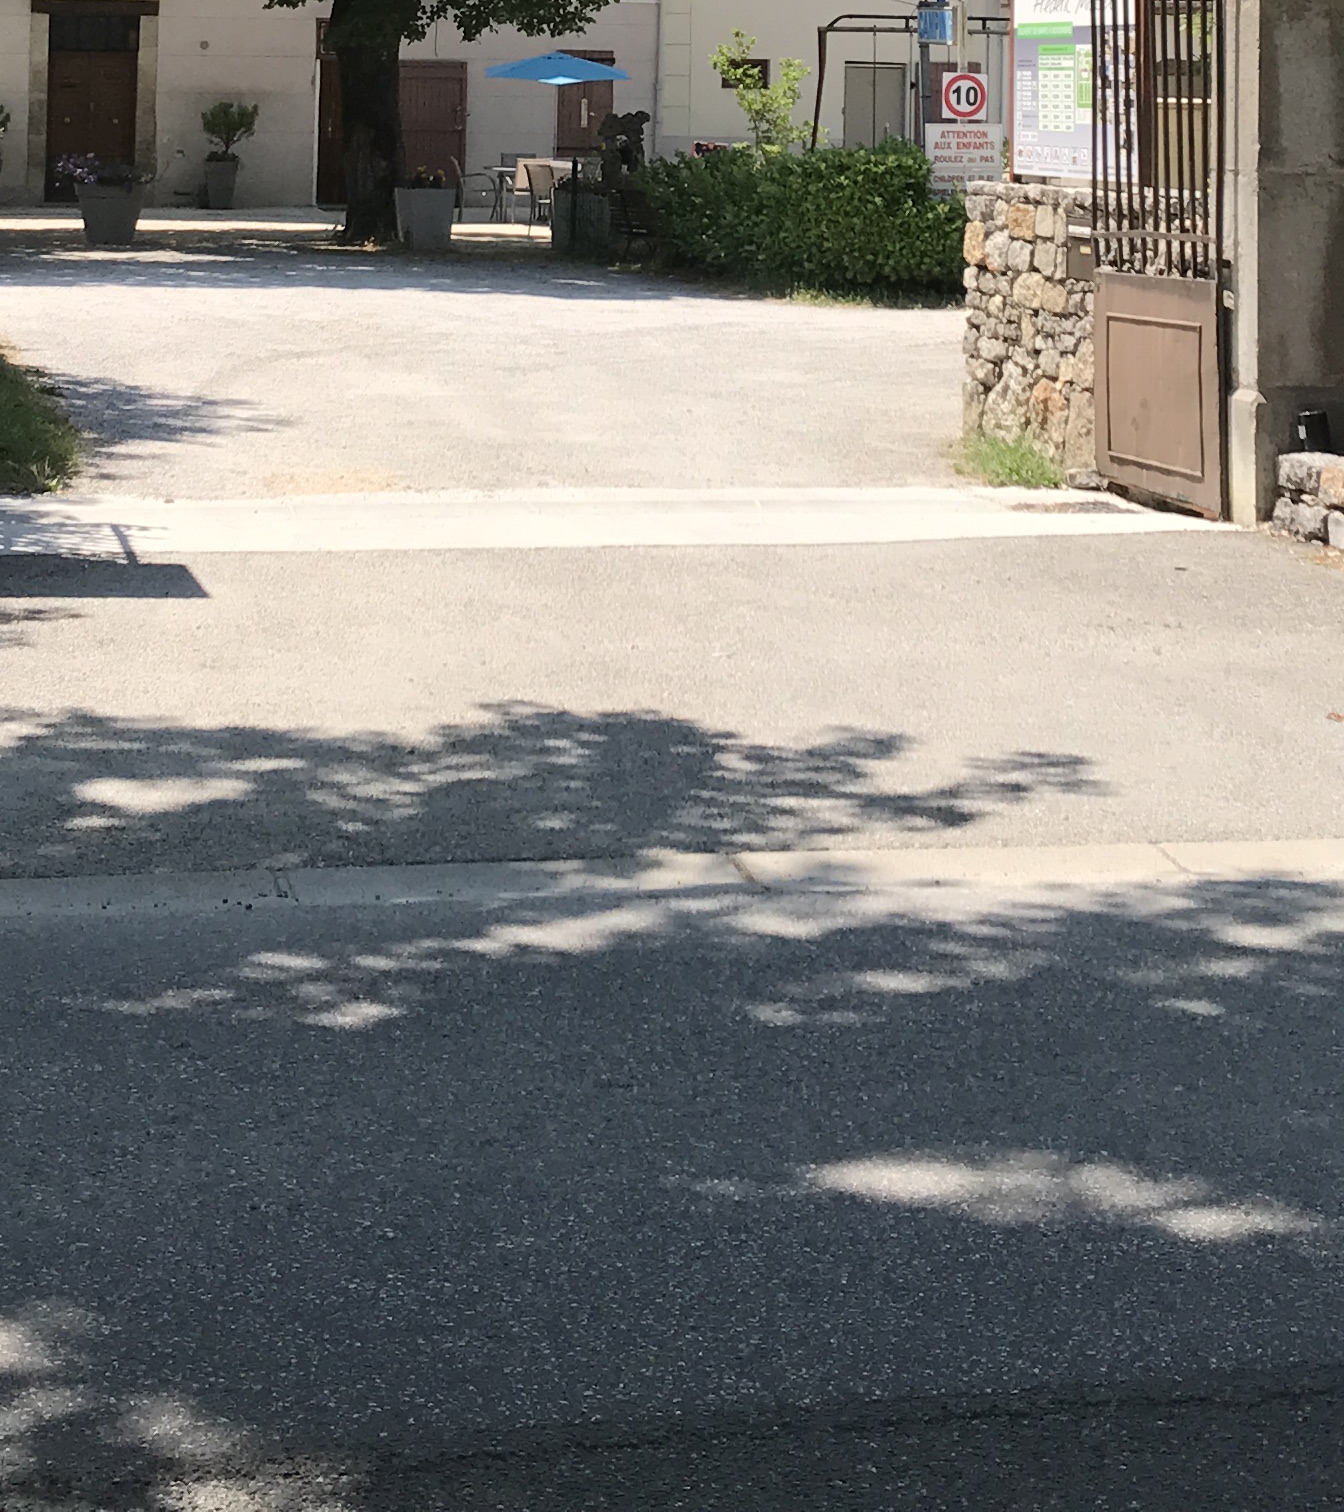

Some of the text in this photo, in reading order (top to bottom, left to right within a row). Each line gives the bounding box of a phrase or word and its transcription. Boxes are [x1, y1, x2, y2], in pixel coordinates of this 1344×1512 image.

[952, 85, 979, 106] 10
[941, 130, 988, 139] ATTENTION
[934, 141, 995, 150] AUX ENFANTS
[934, 155, 963, 163] ROULEZ
[980, 155, 994, 163] PAS
